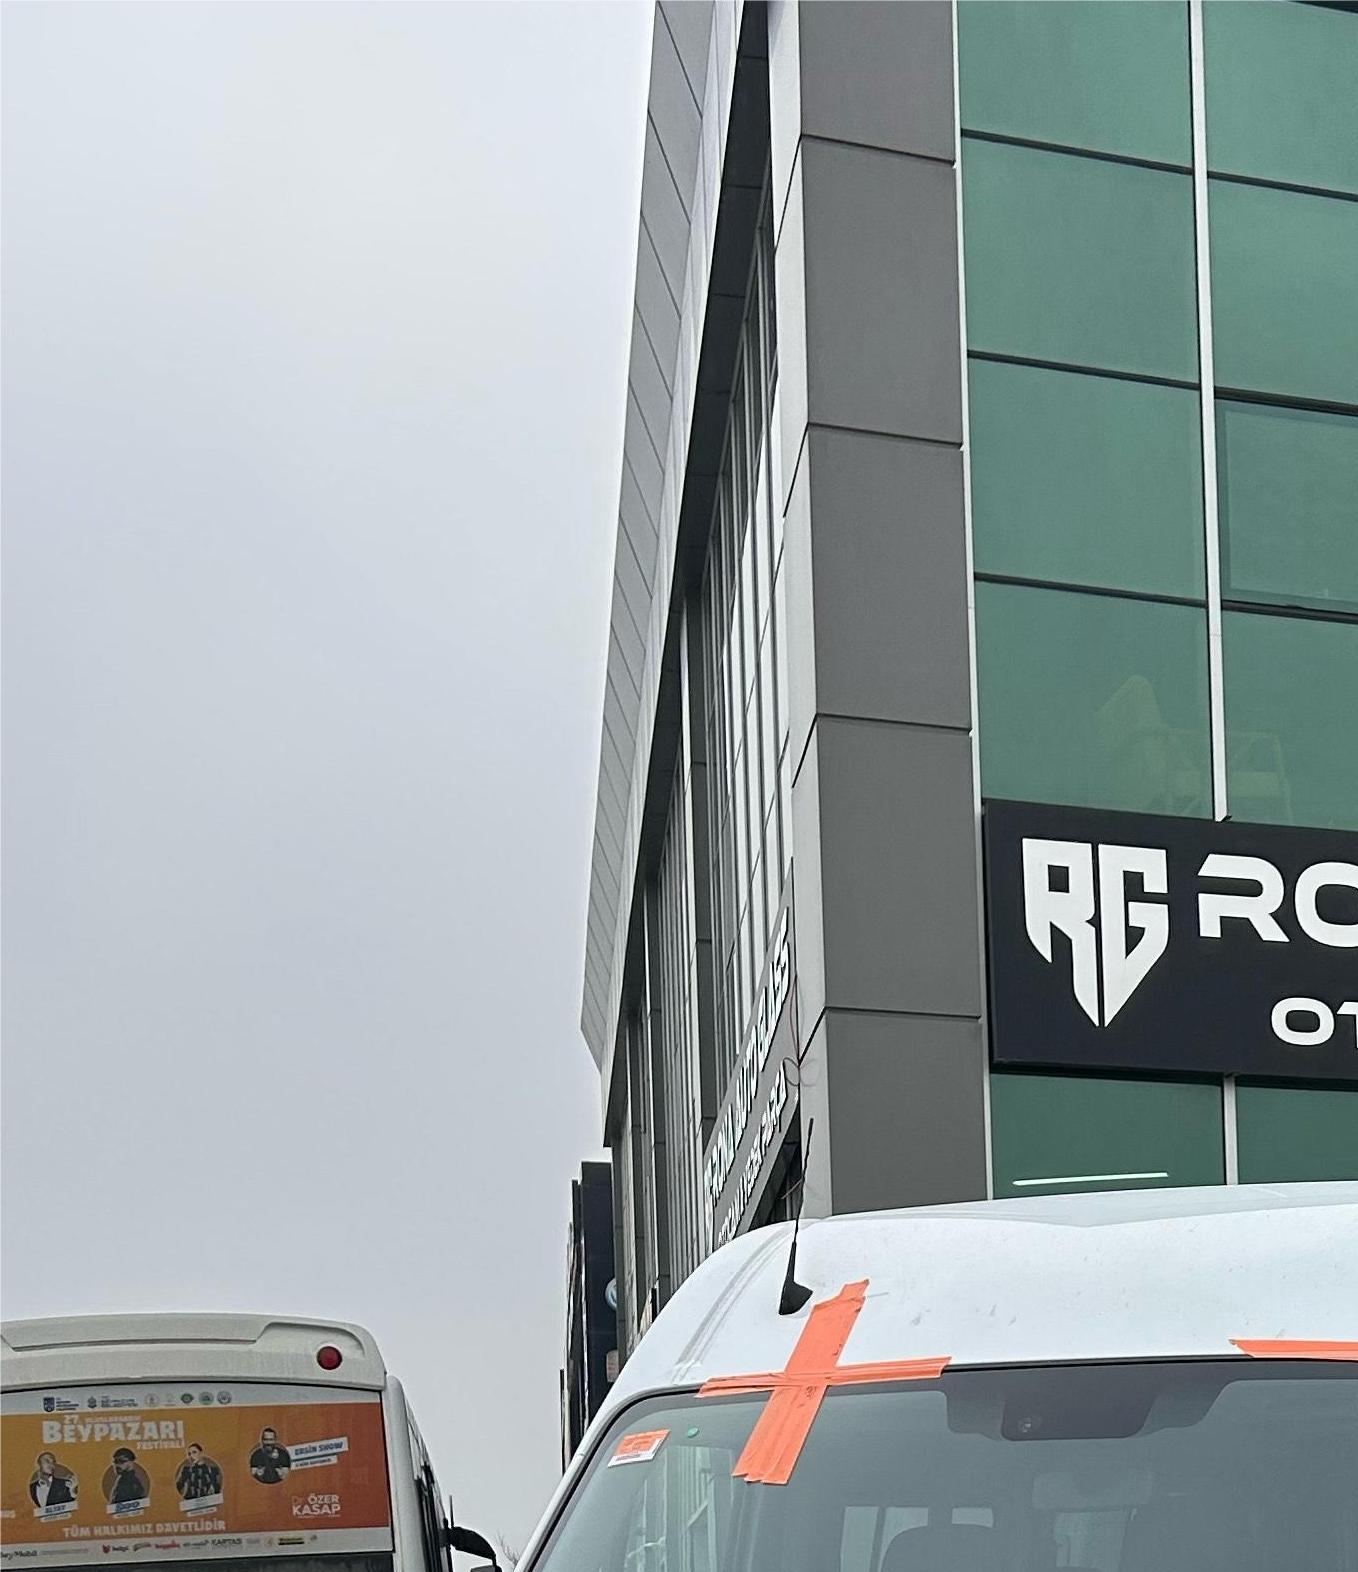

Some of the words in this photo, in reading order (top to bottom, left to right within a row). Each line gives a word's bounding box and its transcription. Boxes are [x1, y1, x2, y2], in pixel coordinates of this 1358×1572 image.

[42, 1420, 184, 1445] BEYPAZARI
[307, 1493, 340, 1505] ÖZER
[292, 1503, 341, 1516] KASAP
[63, 1523, 92, 1538] TÜM
[94, 1522, 153, 1537] HALKIMIZ
[155, 1518, 226, 1533] DAVETLİDİR
